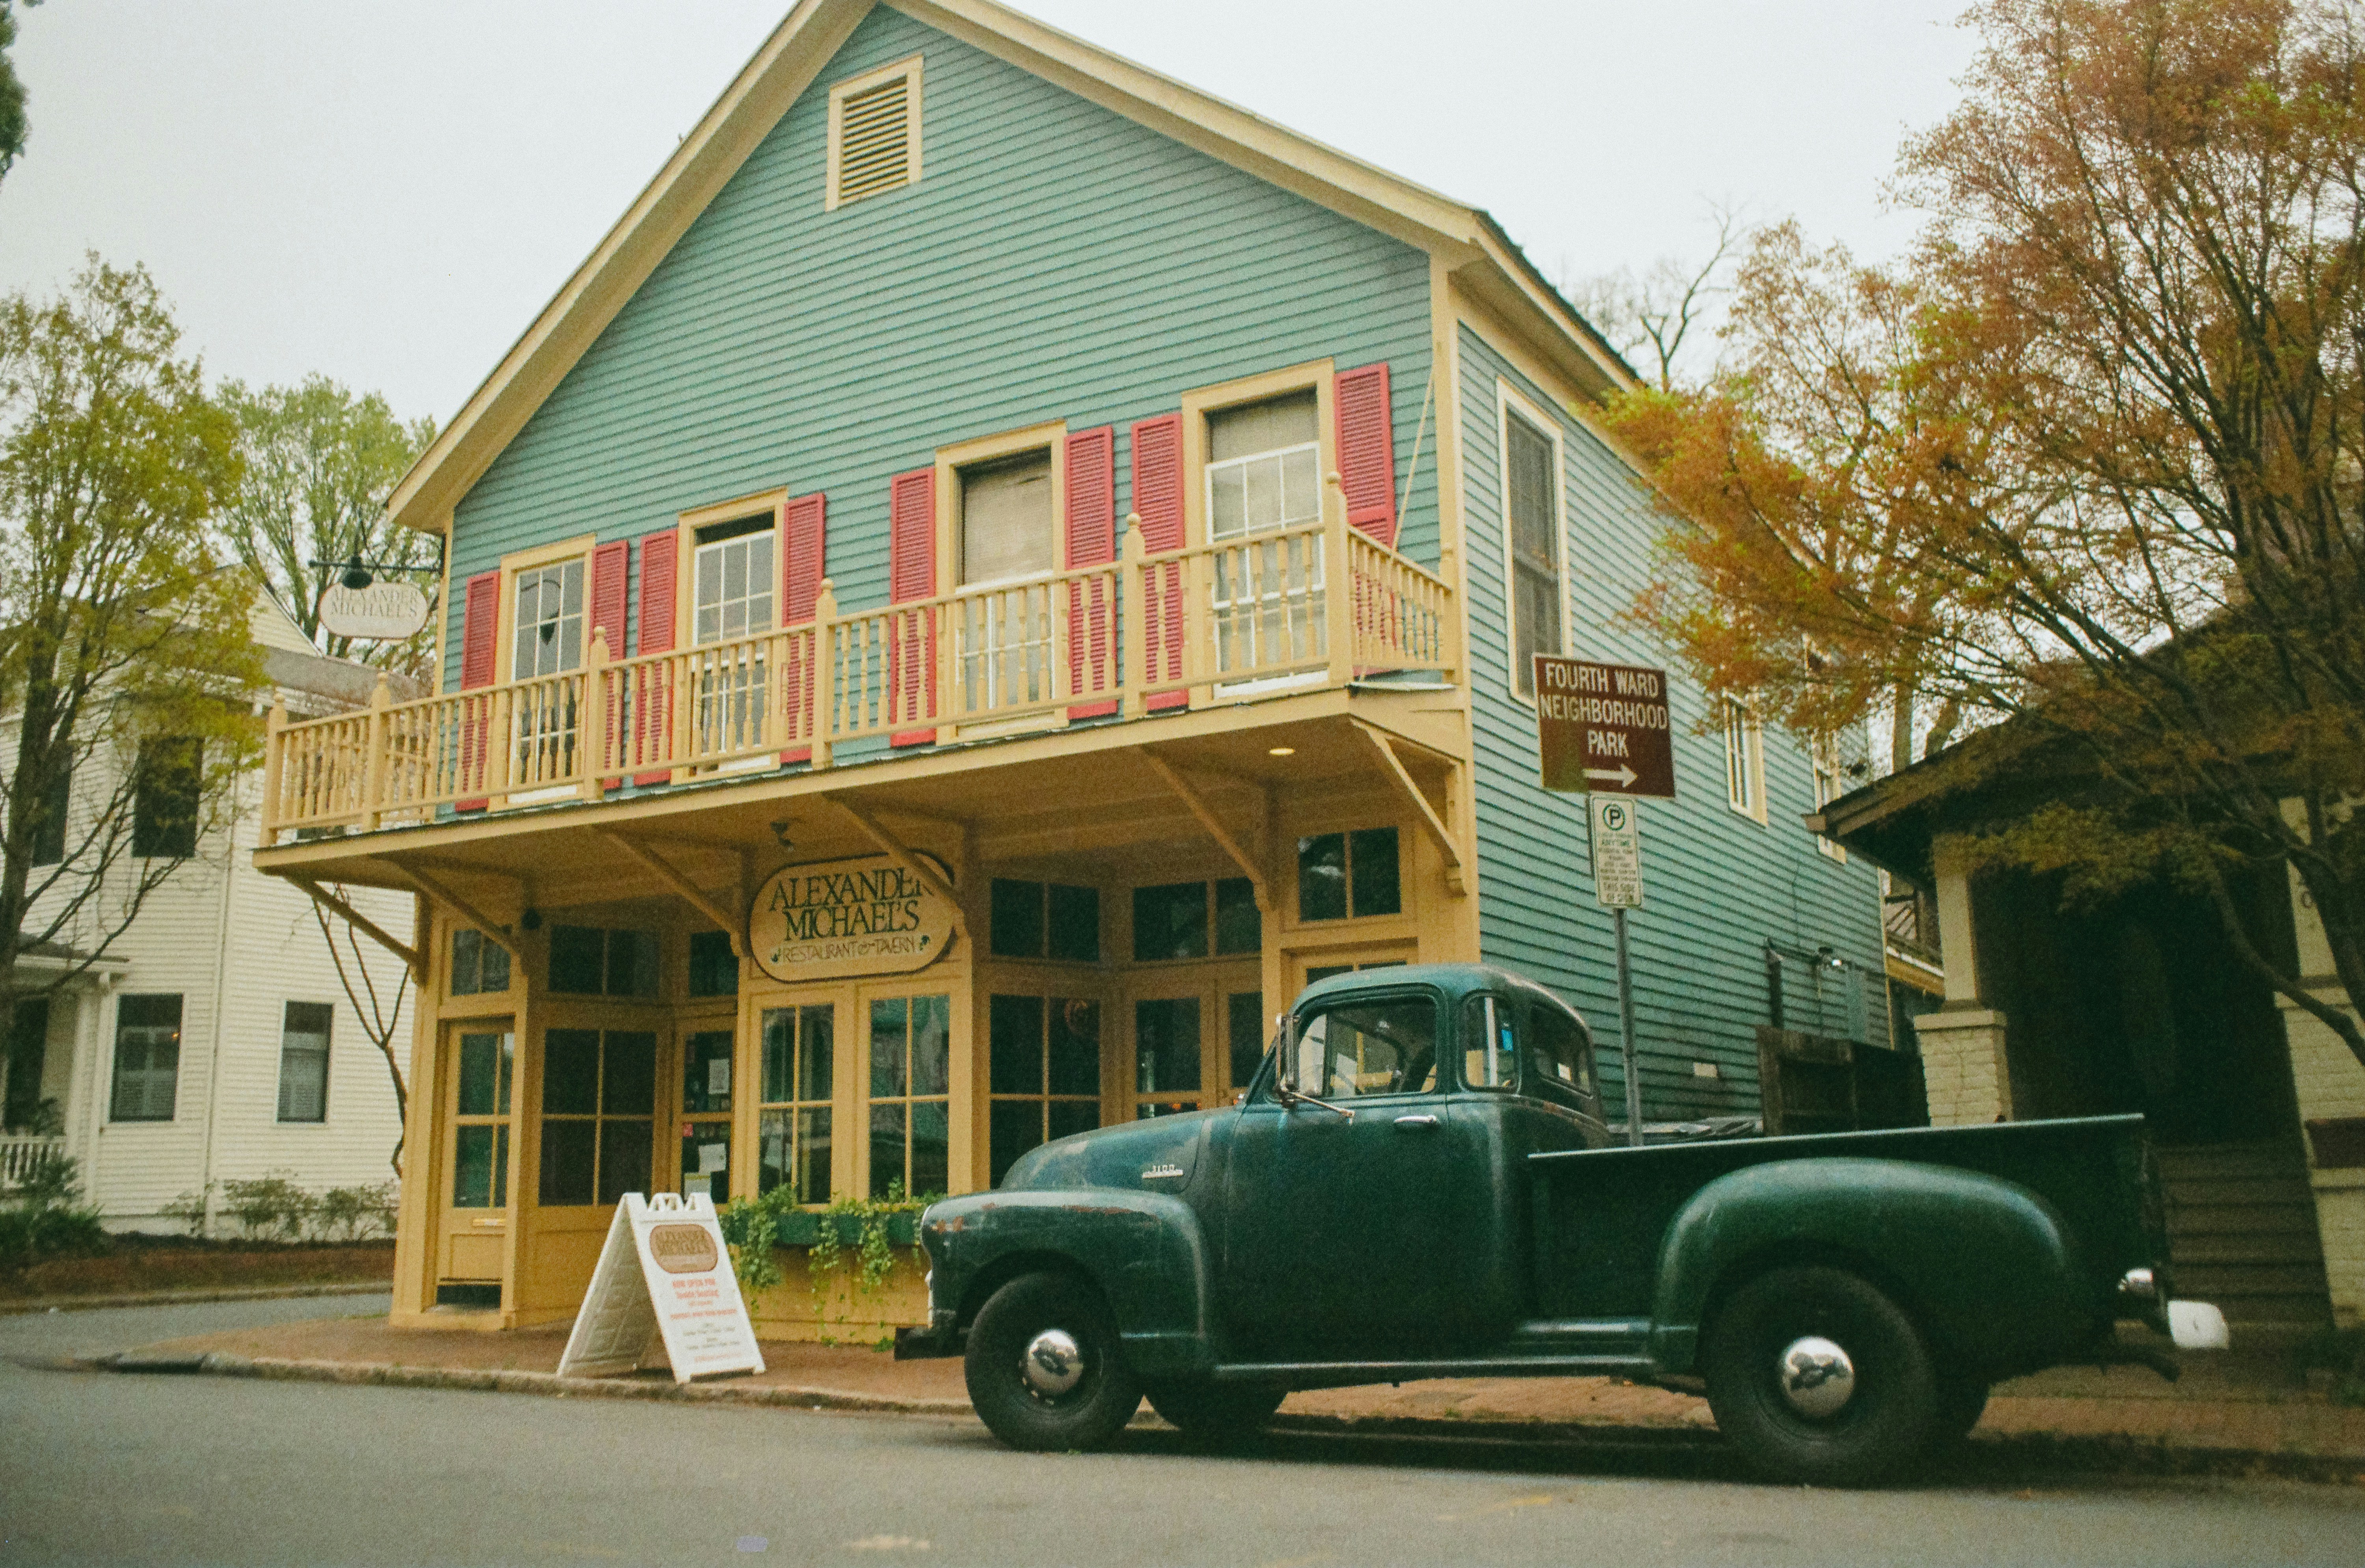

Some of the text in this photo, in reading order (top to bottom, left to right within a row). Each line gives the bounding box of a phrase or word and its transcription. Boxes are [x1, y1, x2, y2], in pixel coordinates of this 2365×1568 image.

[1546, 662, 1659, 698] FOURTH WARD
[1540, 694, 1667, 729] NEIGHBORHOOD
[1587, 729, 1630, 758] PARK
[782, 900, 920, 941] MICHAEL'S
[783, 941, 857, 963] RESTAURANT
[873, 936, 915, 954] TAVERN
